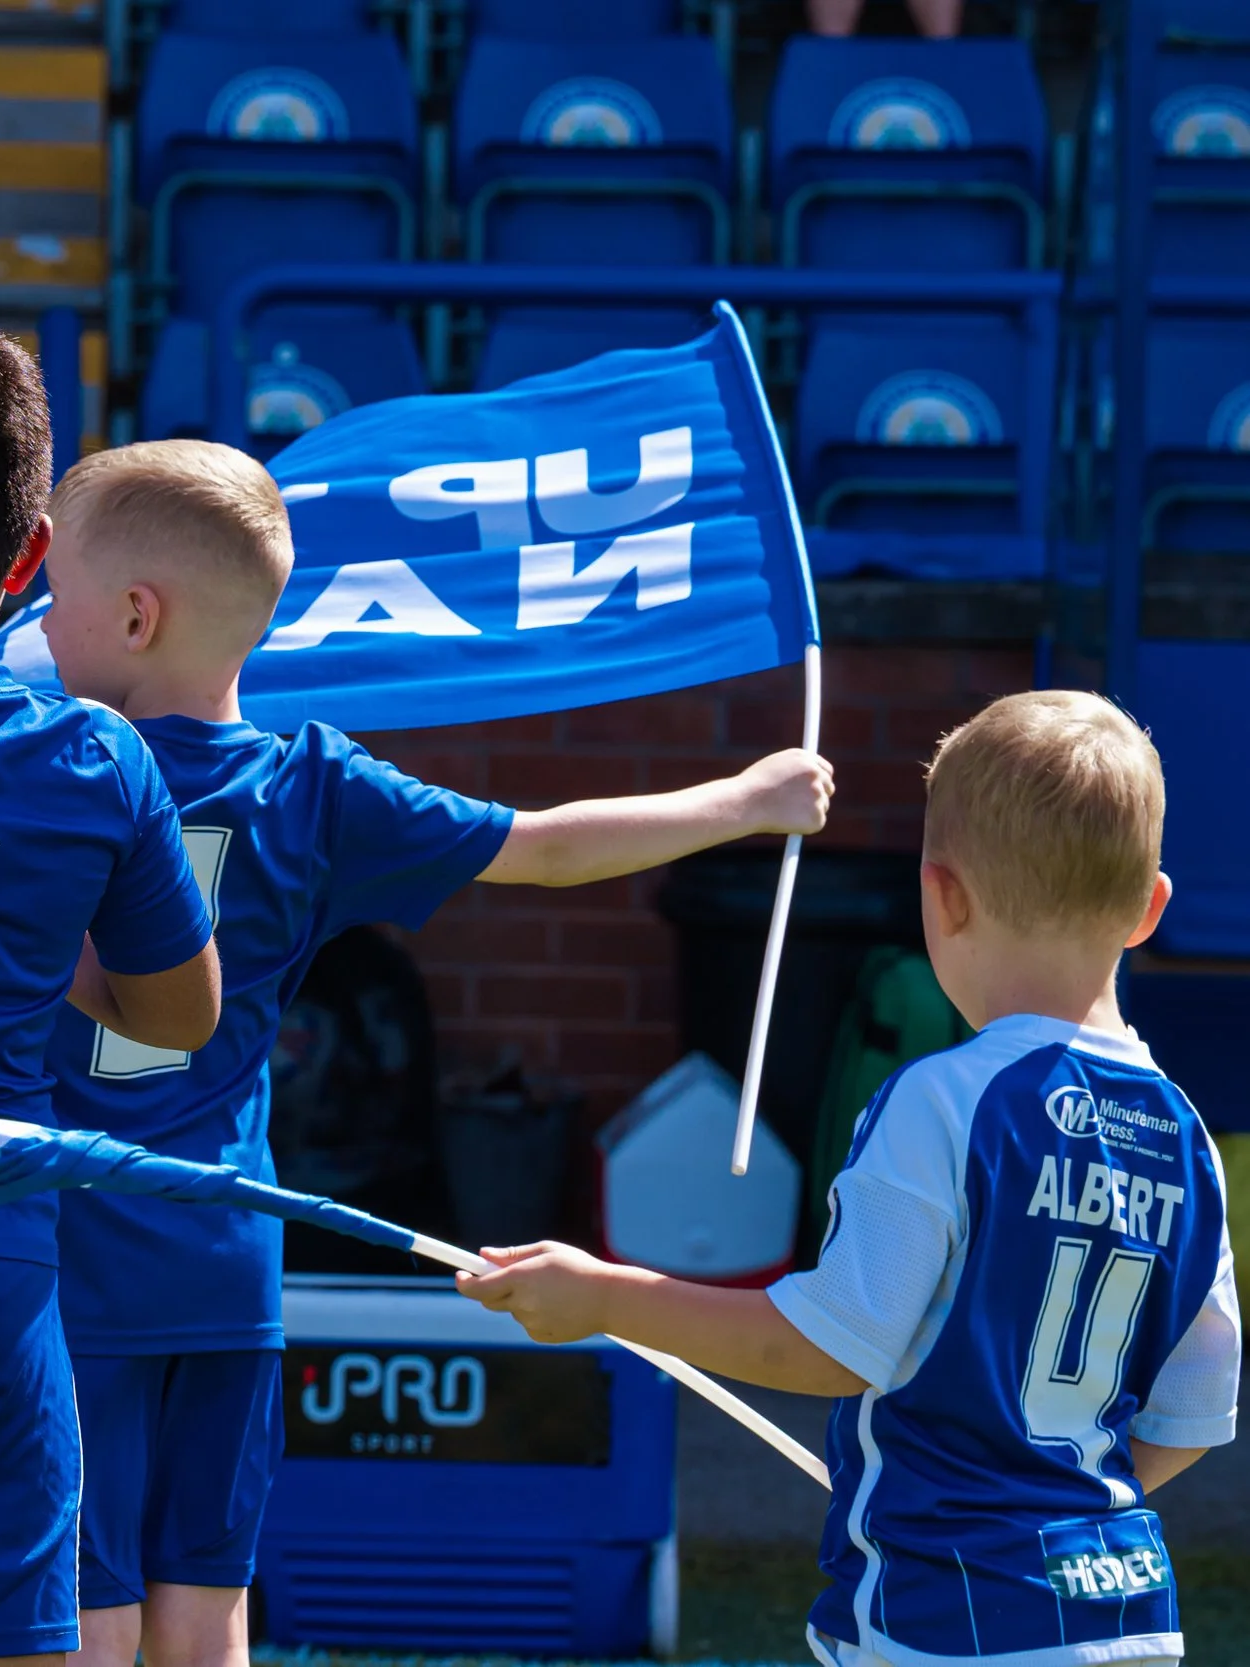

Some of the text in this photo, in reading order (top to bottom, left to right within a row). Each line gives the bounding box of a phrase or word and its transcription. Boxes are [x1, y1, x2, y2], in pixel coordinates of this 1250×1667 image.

[1098, 1116, 1137, 1142] Press.
[1099, 1098, 1179, 1135] Minuteman
[1026, 1154, 1185, 1247] ALBERT
[1020, 1236, 1156, 1509] 4
[350, 1433, 435, 1454] SPORT
